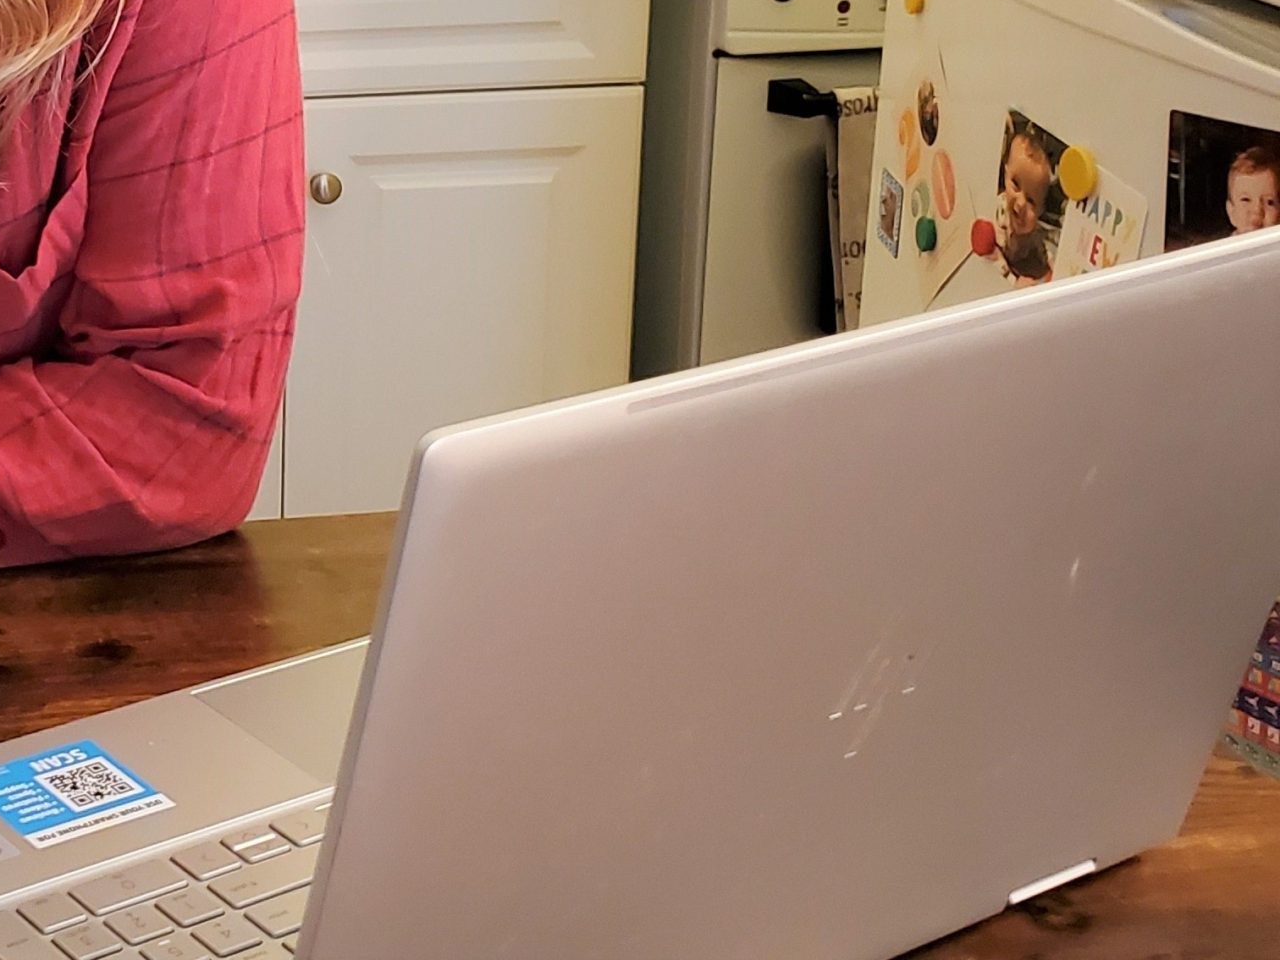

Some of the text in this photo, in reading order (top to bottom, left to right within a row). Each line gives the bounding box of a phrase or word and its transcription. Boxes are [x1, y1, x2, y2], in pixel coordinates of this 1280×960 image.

[27, 746, 88, 773] SCAN
[119, 804, 144, 817] YOUR
[56, 812, 120, 836] SMARTPHONE
[36, 831, 57, 843] FOR
